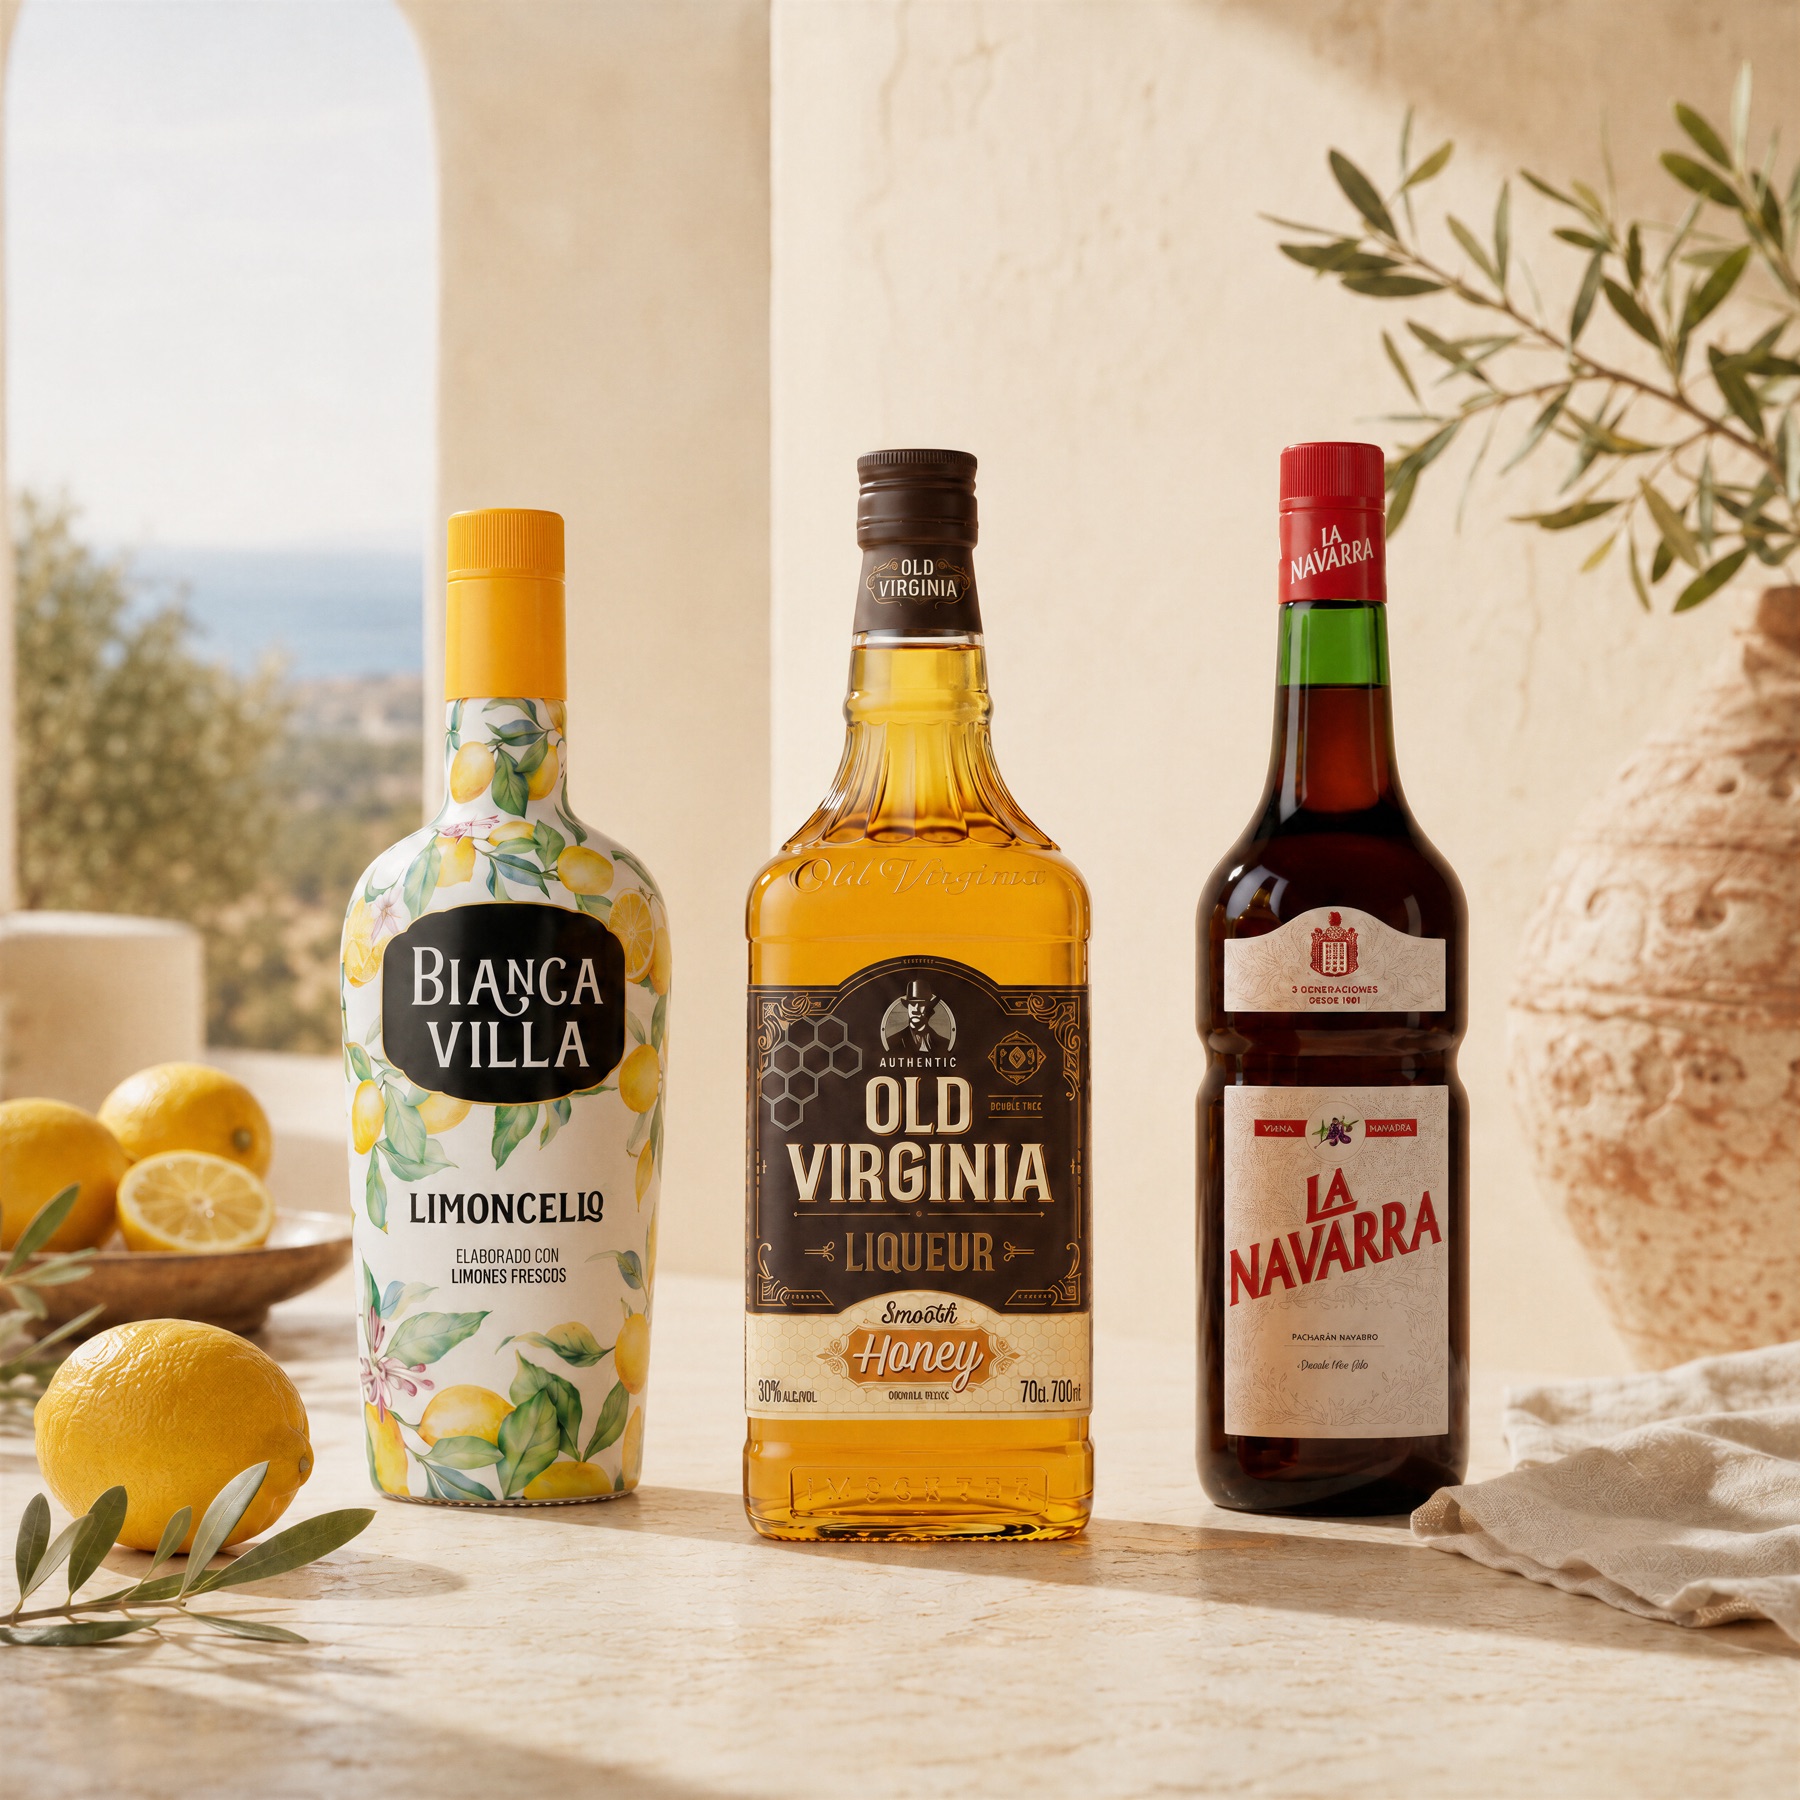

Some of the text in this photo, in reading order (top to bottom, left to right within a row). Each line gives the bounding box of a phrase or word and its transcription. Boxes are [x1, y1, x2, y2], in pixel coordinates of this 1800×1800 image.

[1321, 524, 1343, 548] LA
[901, 559, 934, 576] OLD
[879, 579, 958, 598] VIRGINIA
[411, 946, 604, 1017] BIANCA
[1291, 985, 1298, 994] 3
[426, 1021, 590, 1068] VILLA
[879, 1057, 957, 1068] AUTHENTIC
[865, 1075, 974, 1137] OLD
[786, 1141, 1055, 1204] VIRGINIA
[410, 1190, 604, 1225] LIMONCELLO
[1306, 1167, 1359, 1225] LA
[456, 1248, 560, 1264] ELABORADO CON
[845, 1232, 996, 1274] LIQUEUR
[1229, 1190, 1443, 1307] NAVARRA
[451, 1267, 567, 1284] LIMONES FRESCOS
[881, 1300, 958, 1324] Smooth
[853, 1333, 985, 1393] Honey
[758, 1379, 782, 1403] 30%
